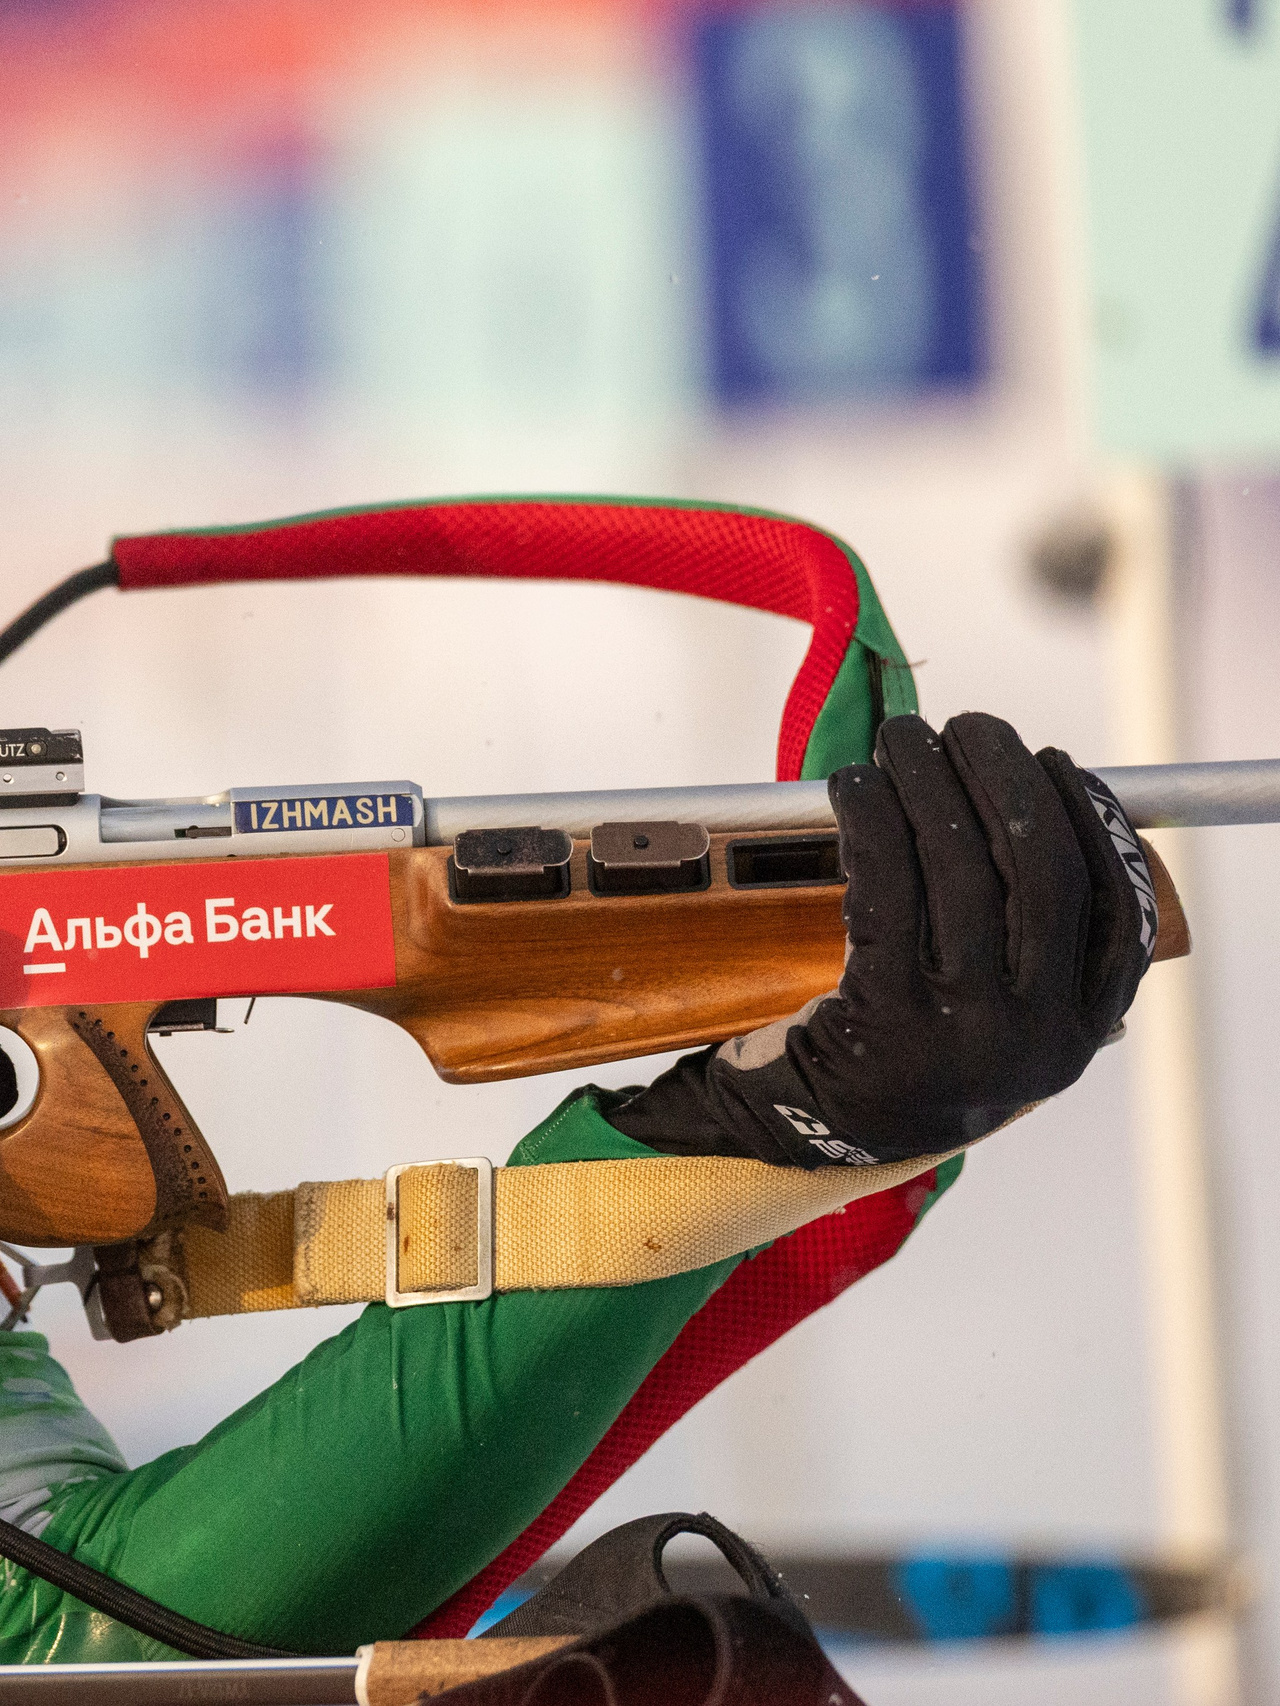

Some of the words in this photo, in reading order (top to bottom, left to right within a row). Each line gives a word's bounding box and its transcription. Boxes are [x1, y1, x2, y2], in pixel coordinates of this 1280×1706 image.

[250, 795, 398, 830] IZHMASH
[23, 901, 195, 959] Альфа
[205, 897, 337, 943] Банк
